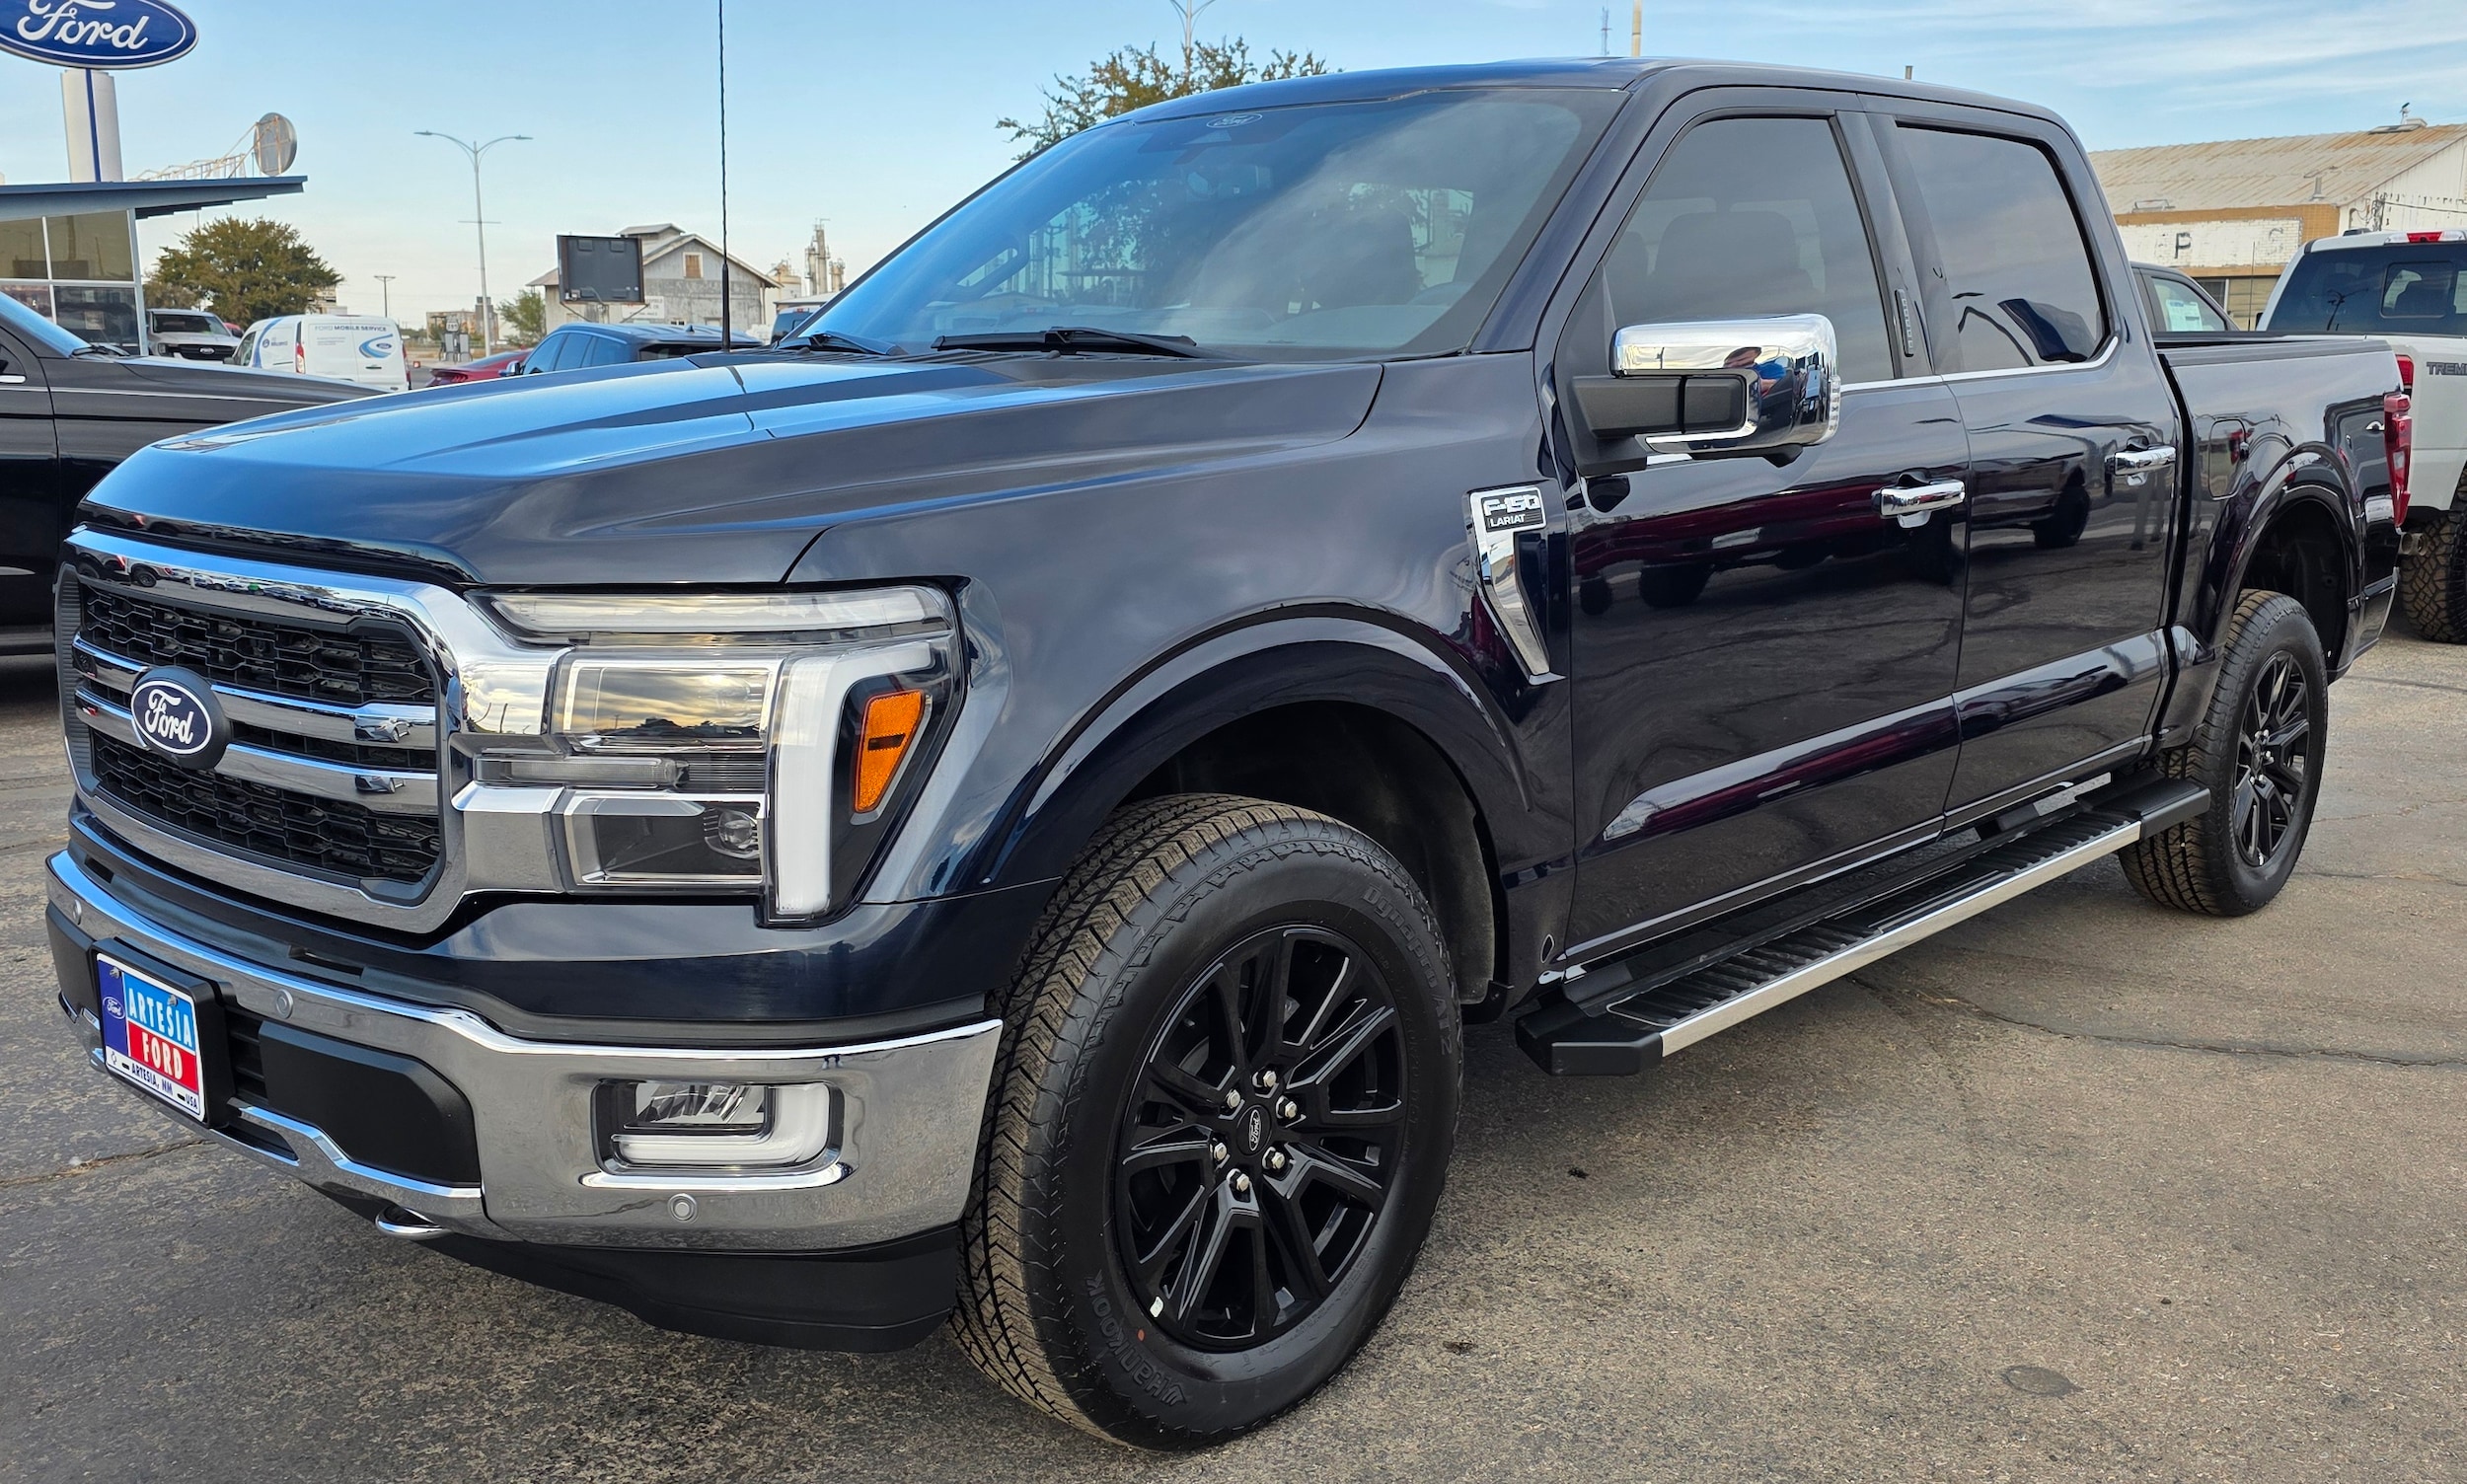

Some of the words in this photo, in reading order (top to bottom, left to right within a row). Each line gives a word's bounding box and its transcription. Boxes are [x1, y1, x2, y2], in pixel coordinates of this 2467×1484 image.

[17, 0, 150, 49] Ford
[2426, 361, 2467, 376] TREM
[1483, 494, 1540, 516] F-150
[1489, 513, 1526, 528] LARIAT
[145, 689, 194, 745] Ford
[1361, 883, 1438, 988] Dynapro
[107, 999, 121, 1016] Ford
[127, 988, 192, 1048] ARTESIA
[141, 1031, 183, 1080] FORD
[131, 1063, 160, 1089] ARTESIA,
[161, 1078, 174, 1095] NM
[185, 1093, 198, 1110] USA
[1250, 1117, 1260, 1144] Ford
